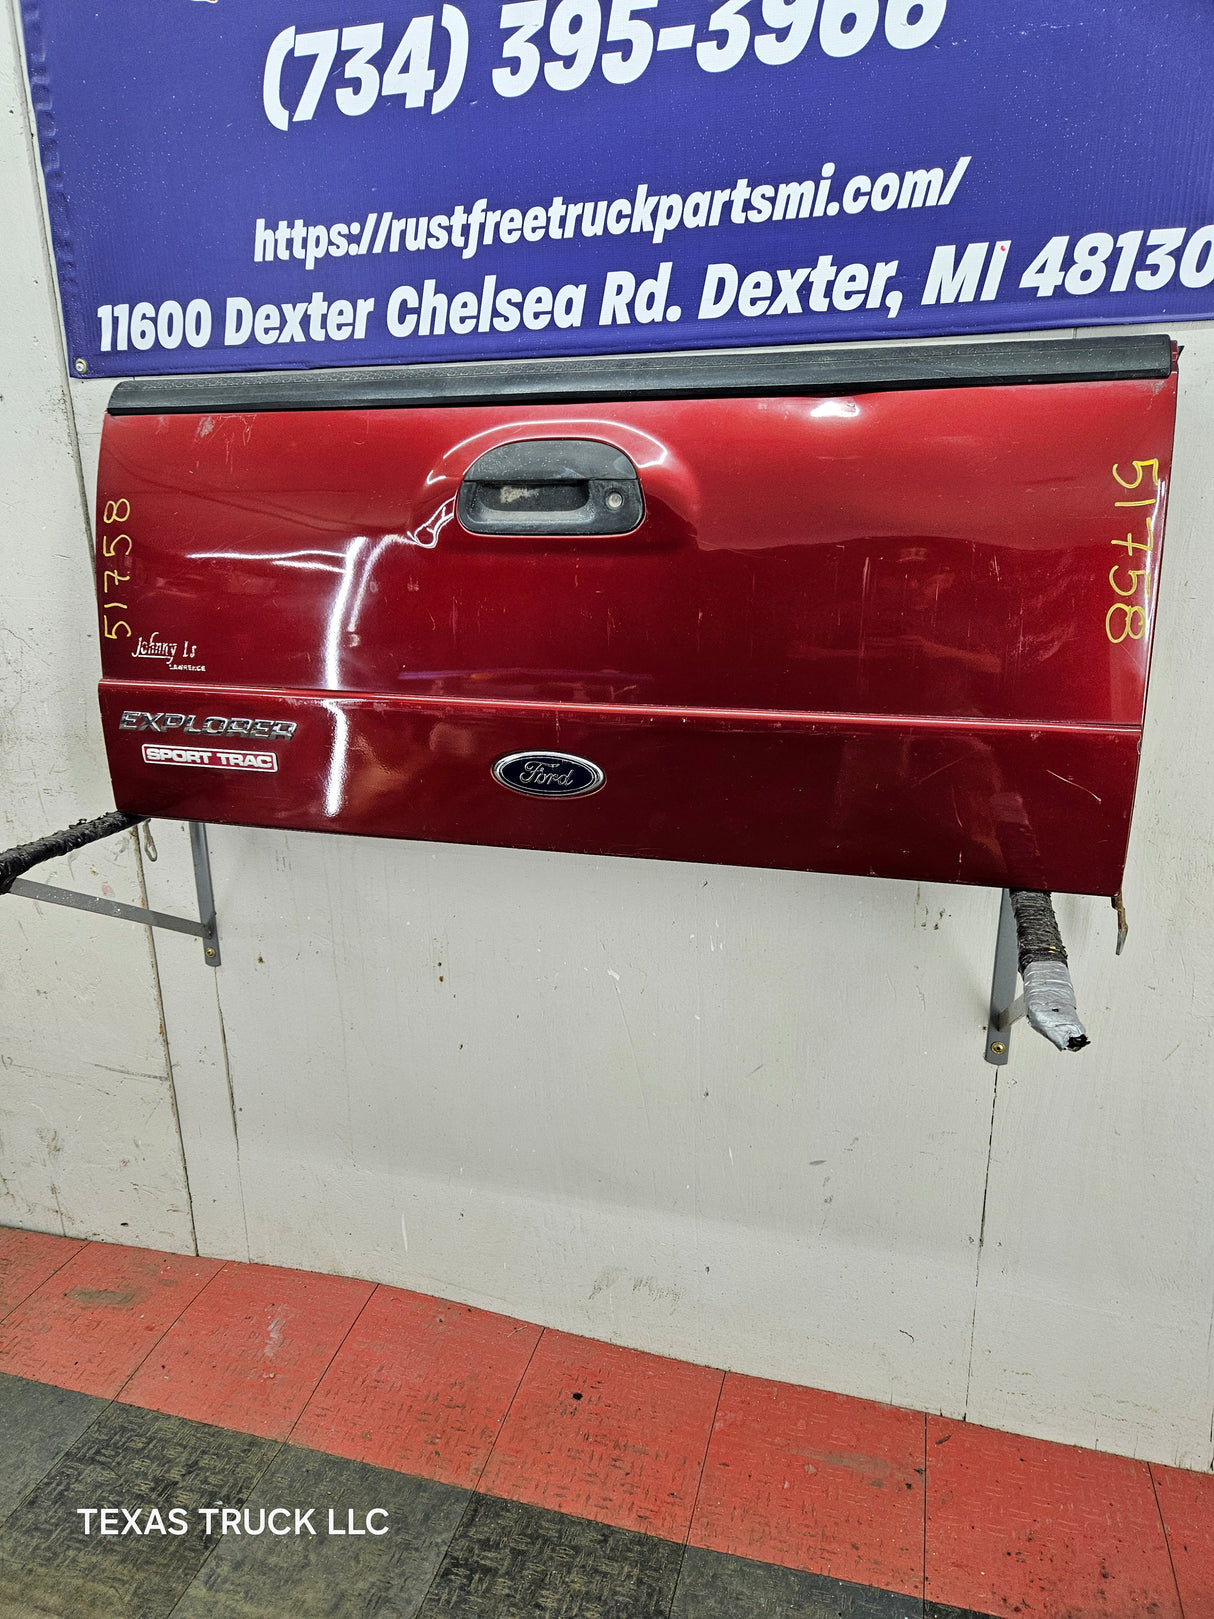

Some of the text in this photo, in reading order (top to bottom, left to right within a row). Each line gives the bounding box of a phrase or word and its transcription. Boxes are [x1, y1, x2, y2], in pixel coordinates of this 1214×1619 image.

[262, 3, 469, 131] (734)
[253, 156, 972, 270] https://rustfreetruckpartsmi.com/
[97, 224, 1214, 352] 11600 Dexter Chelsea Rd. Dexter, MI 48130
[102, 498, 132, 639] 51758
[1105, 458, 1159, 643] 51758
[118, 710, 298, 741] EXPLORER
[146, 748, 272, 768] SPORT TRAC
[519, 760, 574, 786] Ford
